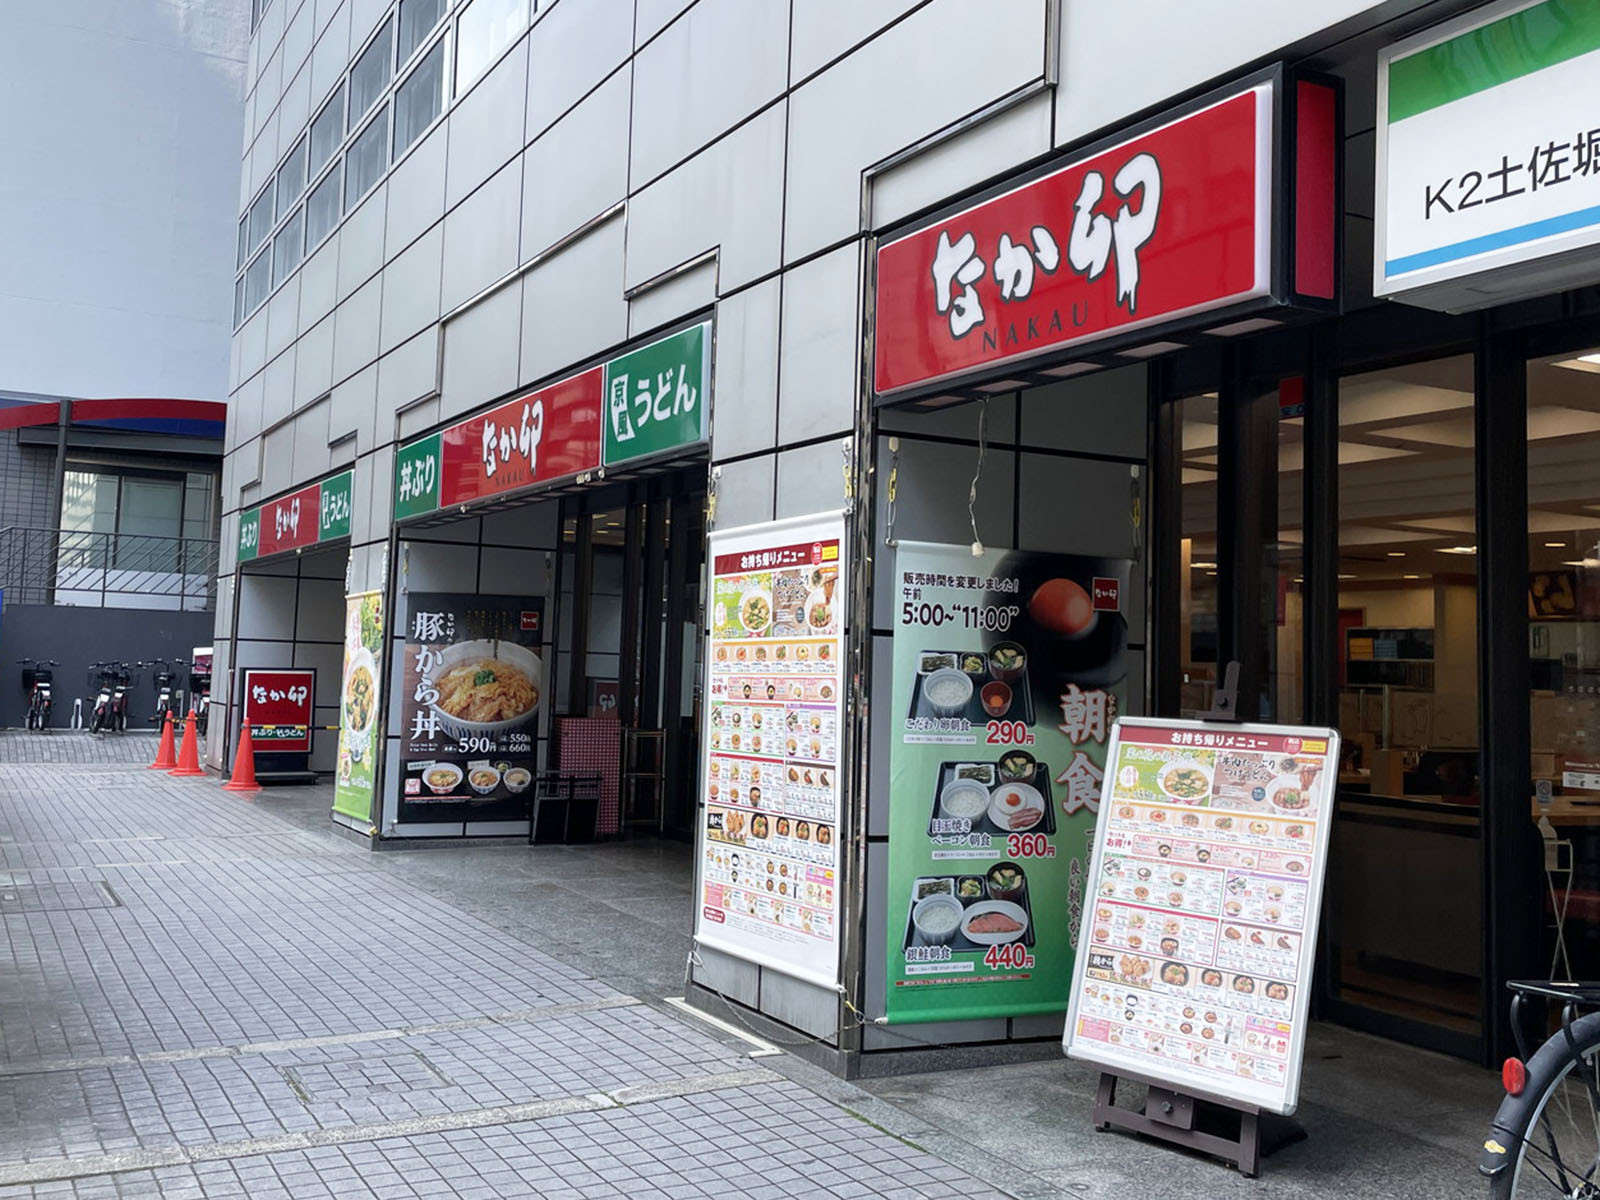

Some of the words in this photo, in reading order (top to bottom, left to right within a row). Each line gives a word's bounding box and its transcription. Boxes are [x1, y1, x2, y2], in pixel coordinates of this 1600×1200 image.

[932, 152, 1162, 339] なか卯
[982, 300, 1089, 353] NAKAU
[634, 364, 697, 428] うどん
[482, 399, 543, 479] なか卯
[399, 454, 435, 501] 丼ぶり
[741, 550, 805, 569] お持ち帰りメニュー
[902, 587, 922, 601] 午前
[903, 571, 1019, 593] 販売時間を変更しました!
[410, 612, 445, 740] 豚から丼
[252, 684, 308, 707] なか卯
[458, 737, 496, 753] 590円
[986, 720, 1035, 745] 290円
[1170, 732, 1269, 748] お持ち帰りメニュー
[1056, 683, 1109, 815] 朝食
[931, 817, 972, 833] 目玉焼き
[1007, 833, 1056, 858] 360円
[906, 946, 952, 962] 銀鮭朝食
[984, 944, 1035, 969] 440円
